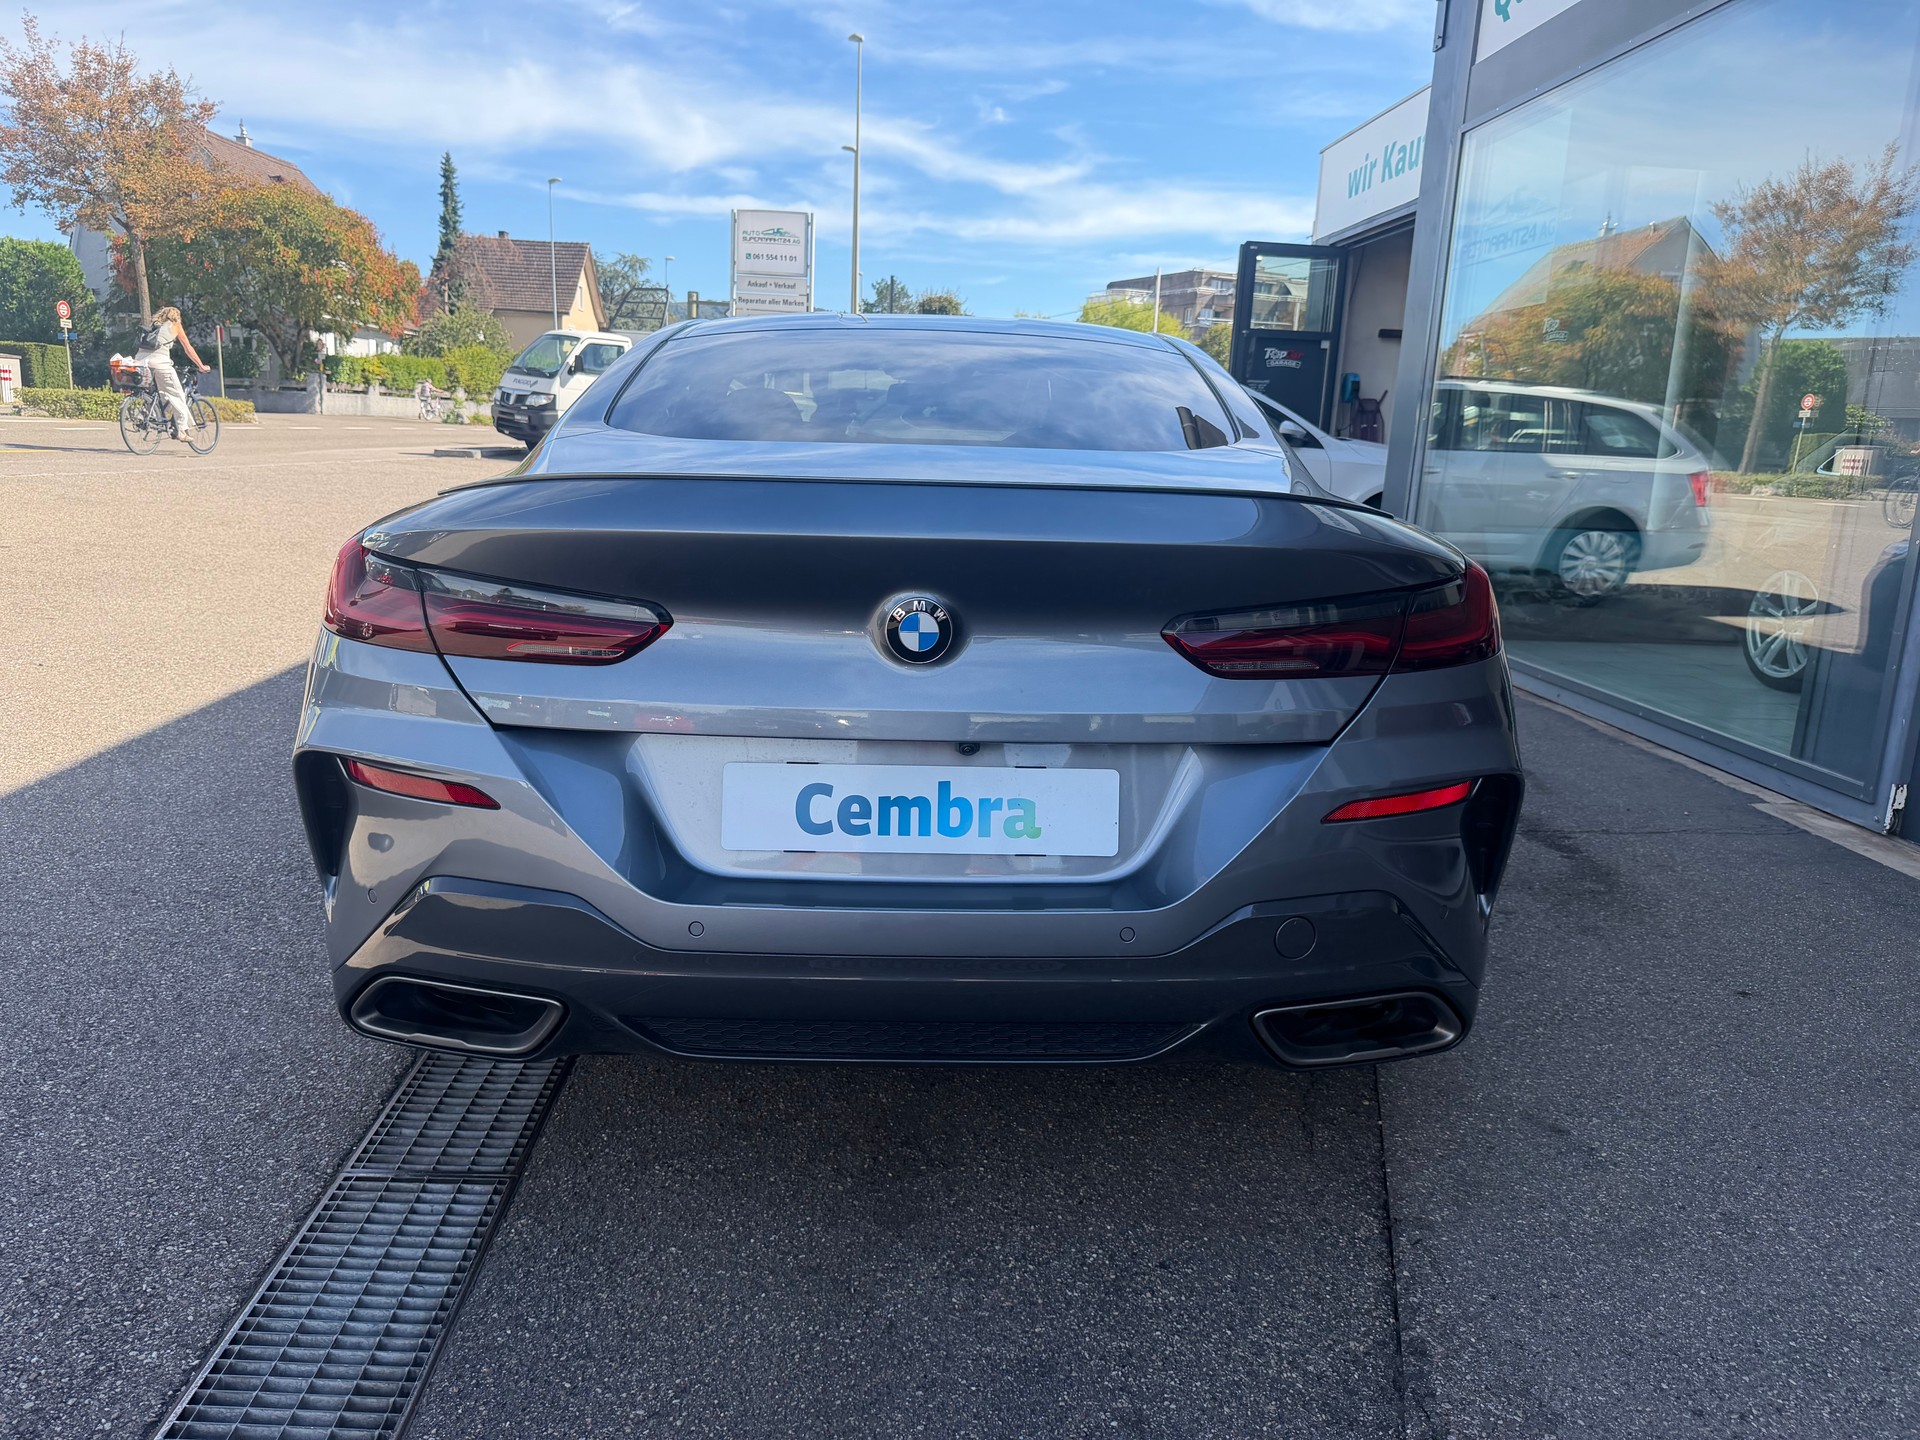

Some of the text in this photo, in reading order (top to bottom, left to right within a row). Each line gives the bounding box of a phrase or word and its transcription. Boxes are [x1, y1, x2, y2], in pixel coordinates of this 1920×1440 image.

[1348, 135, 1425, 199] wir Kau
[780, 254, 788, 262] 11
[747, 280, 768, 288] Ankauf
[774, 281, 797, 289] Verkauf
[738, 296, 805, 307] Reparatur aller Marken
[893, 600, 947, 622] BMW
[795, 780, 1042, 840] Cembra
